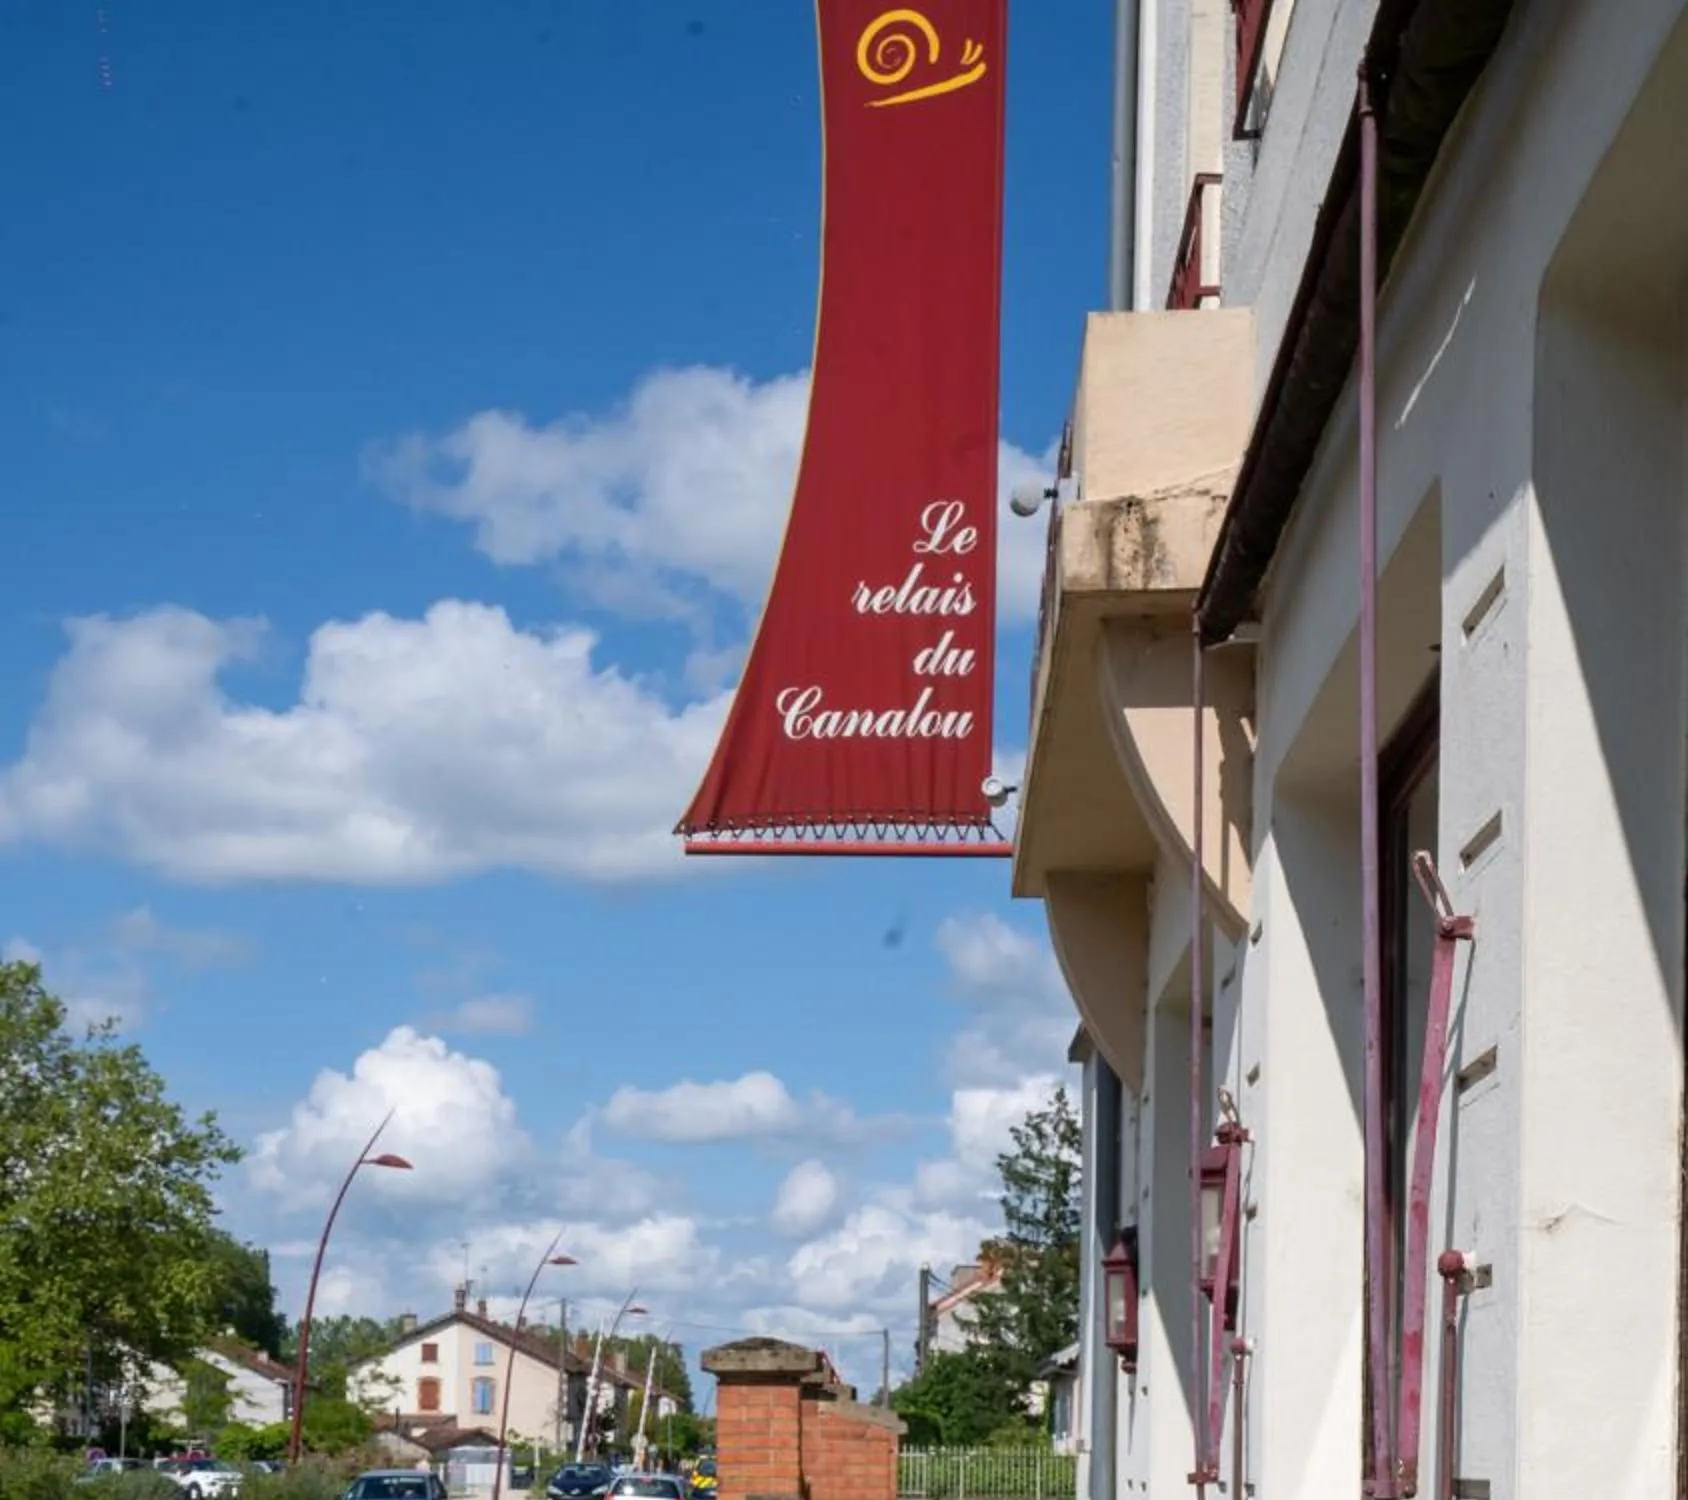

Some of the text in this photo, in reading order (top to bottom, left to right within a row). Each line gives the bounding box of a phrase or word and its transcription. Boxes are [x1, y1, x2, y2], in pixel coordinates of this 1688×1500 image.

[912, 500, 978, 555] Le
[851, 561, 977, 616] relais
[912, 629, 976, 677] du
[775, 685, 974, 741] Canalou
